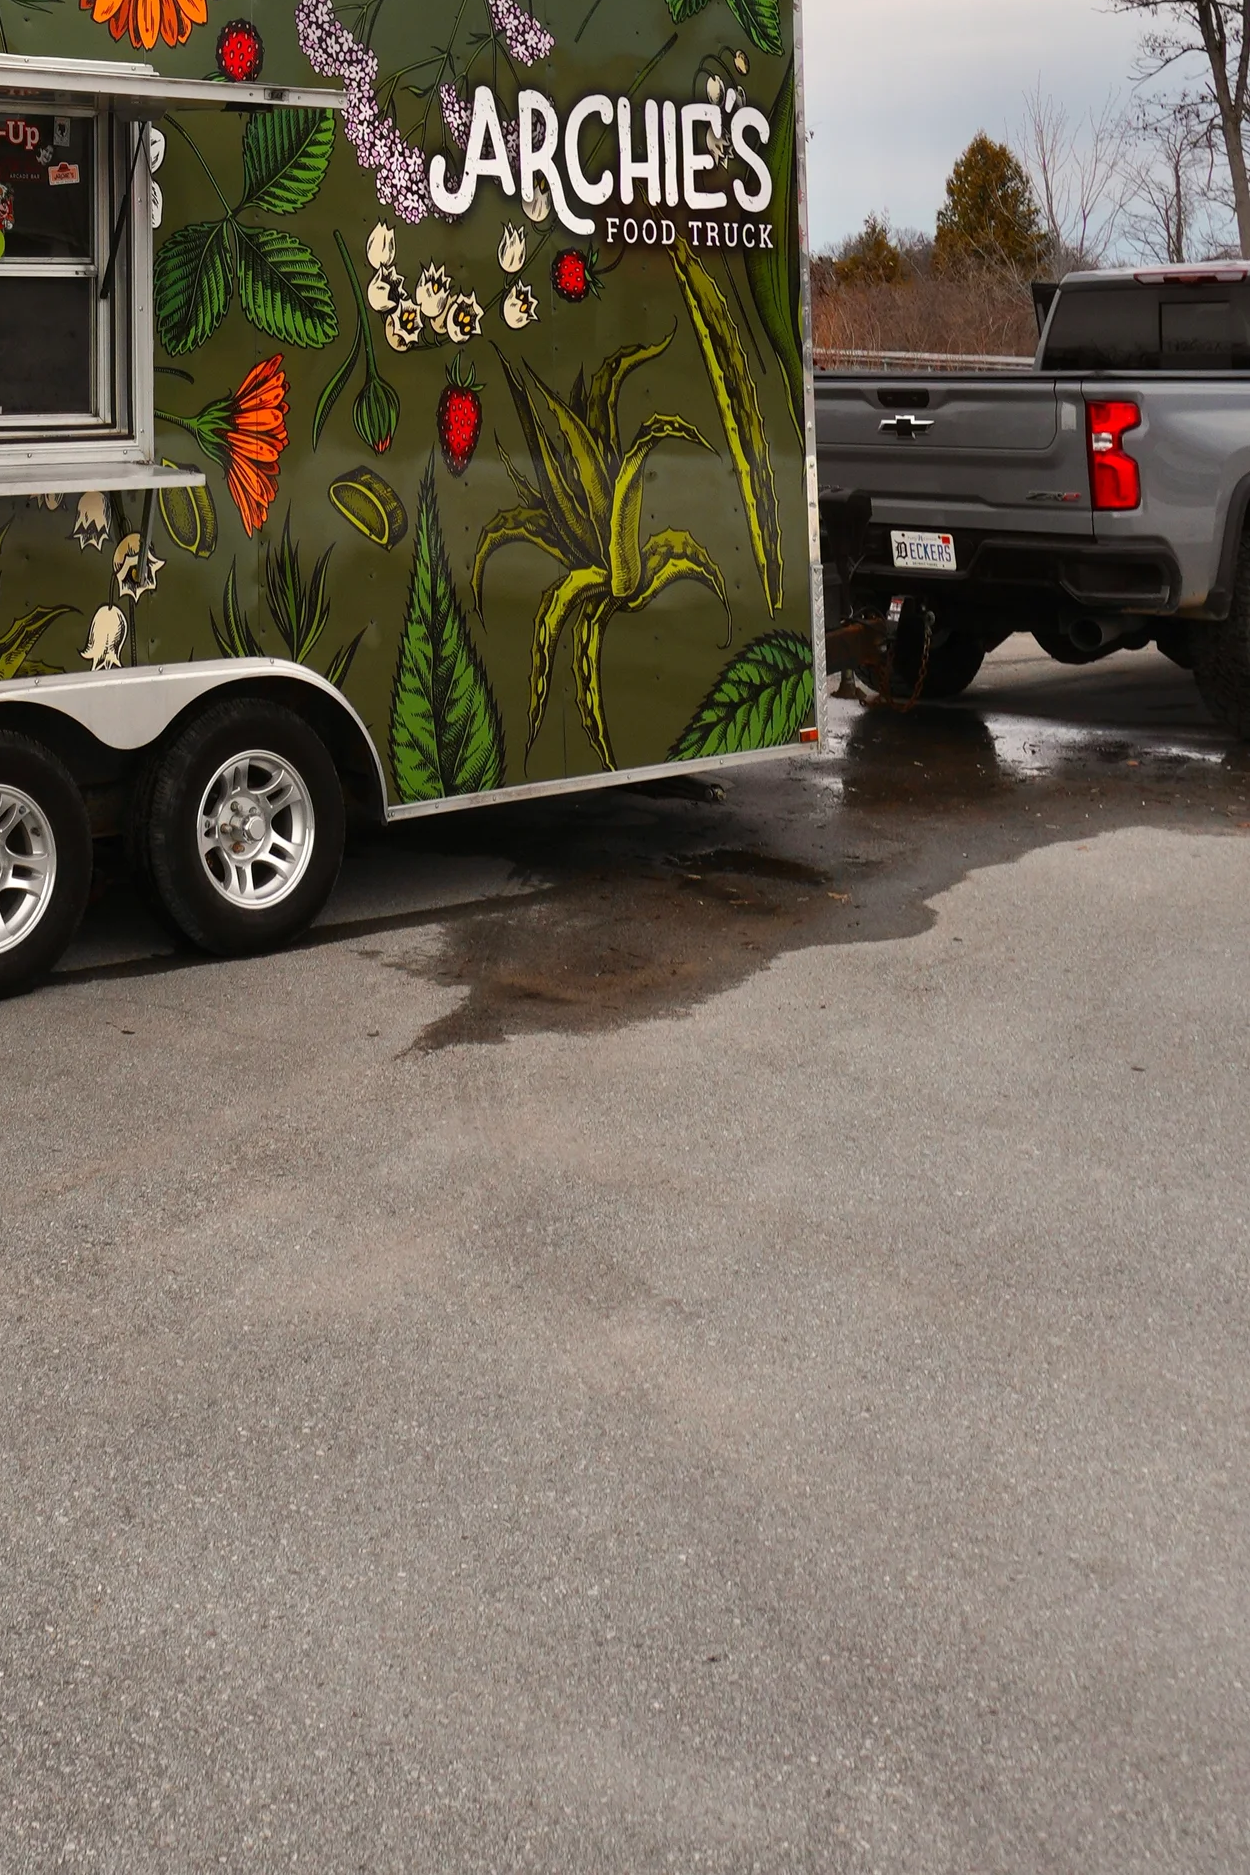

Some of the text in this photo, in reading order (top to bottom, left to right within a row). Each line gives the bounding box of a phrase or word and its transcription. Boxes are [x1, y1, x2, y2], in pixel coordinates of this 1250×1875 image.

[429, 85, 773, 235] ARCHIE'S
[606, 217, 774, 249] FOOD TRUCK
[894, 539, 952, 563] DECKERS
